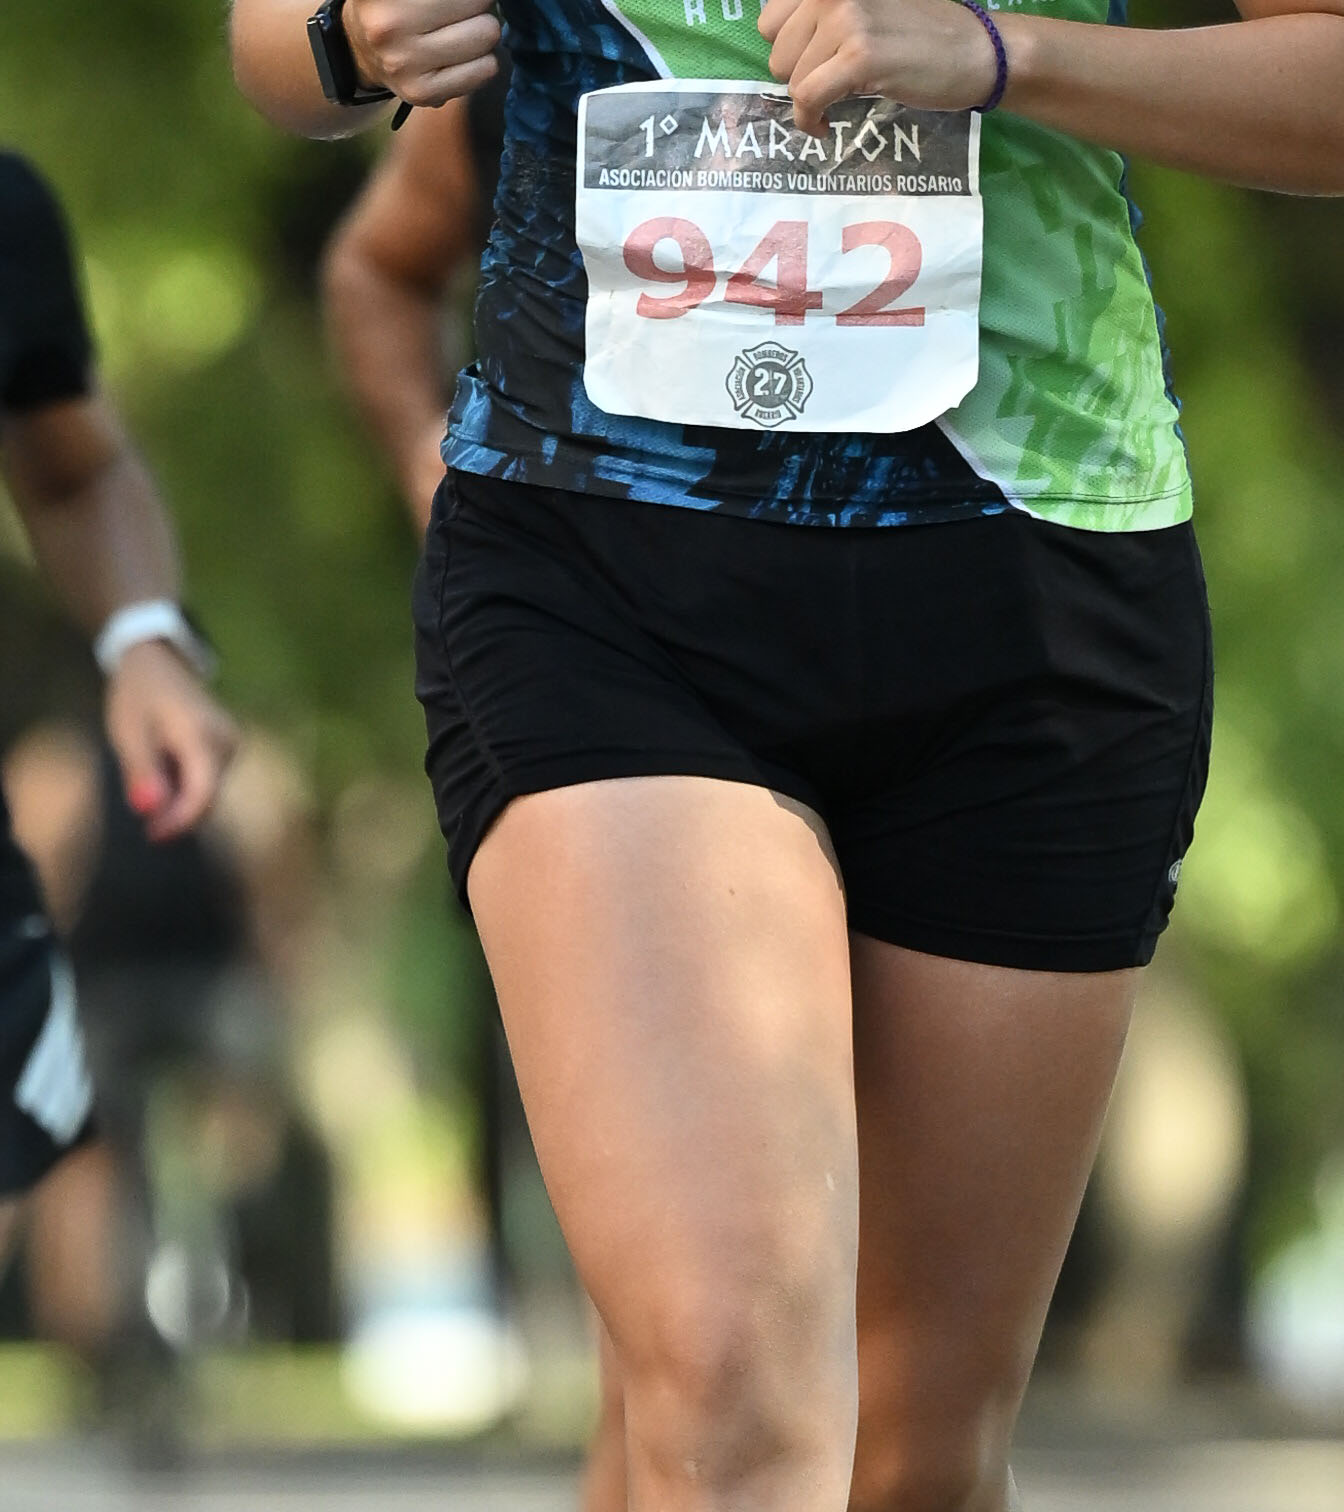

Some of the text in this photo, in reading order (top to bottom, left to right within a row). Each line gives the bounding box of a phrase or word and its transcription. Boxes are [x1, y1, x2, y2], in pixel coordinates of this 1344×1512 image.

[694, 108, 921, 164] MARATÓN
[599, 166, 962, 194] ASOCIACIÓN BOMBEROS VOLUNTARIOS ROSARIO
[623, 217, 925, 327] 942
[754, 368, 787, 396] 27
